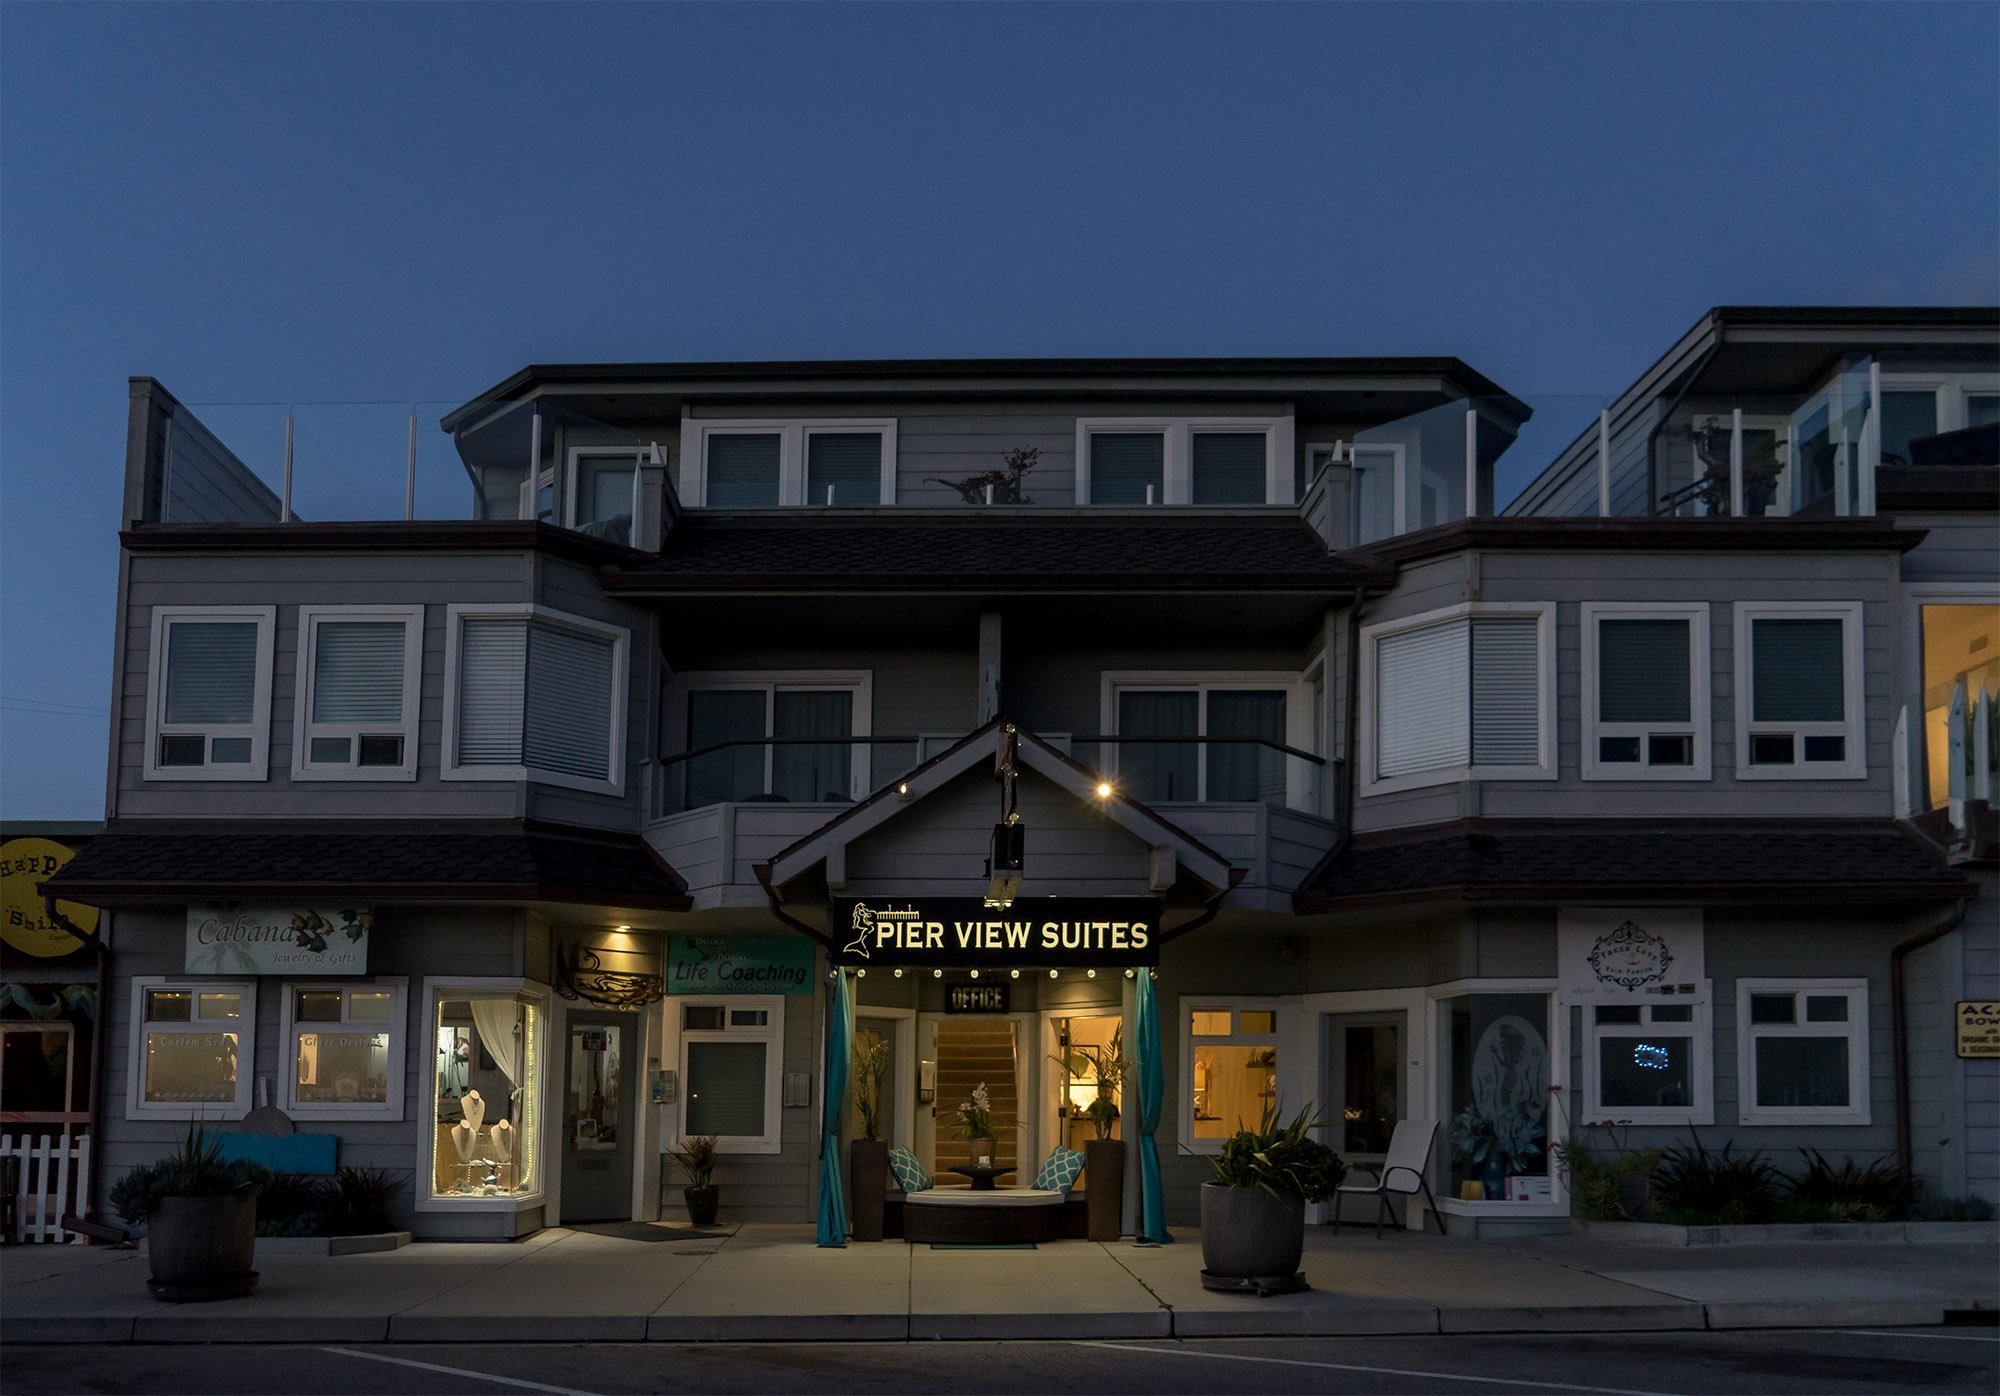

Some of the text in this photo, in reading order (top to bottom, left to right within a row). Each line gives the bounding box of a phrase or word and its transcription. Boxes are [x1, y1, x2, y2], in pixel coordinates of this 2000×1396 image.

[0, 855, 57, 877] Happ
[197, 914, 295, 945] Cabana
[876, 921, 1149, 949] PIER VIEW SUITES
[272, 951, 357, 965] Jewelry & Gifts
[676, 961, 806, 984] Life Coaching
[952, 987, 1003, 1008] OFFICE
[1962, 1004, 2000, 1015] AC
